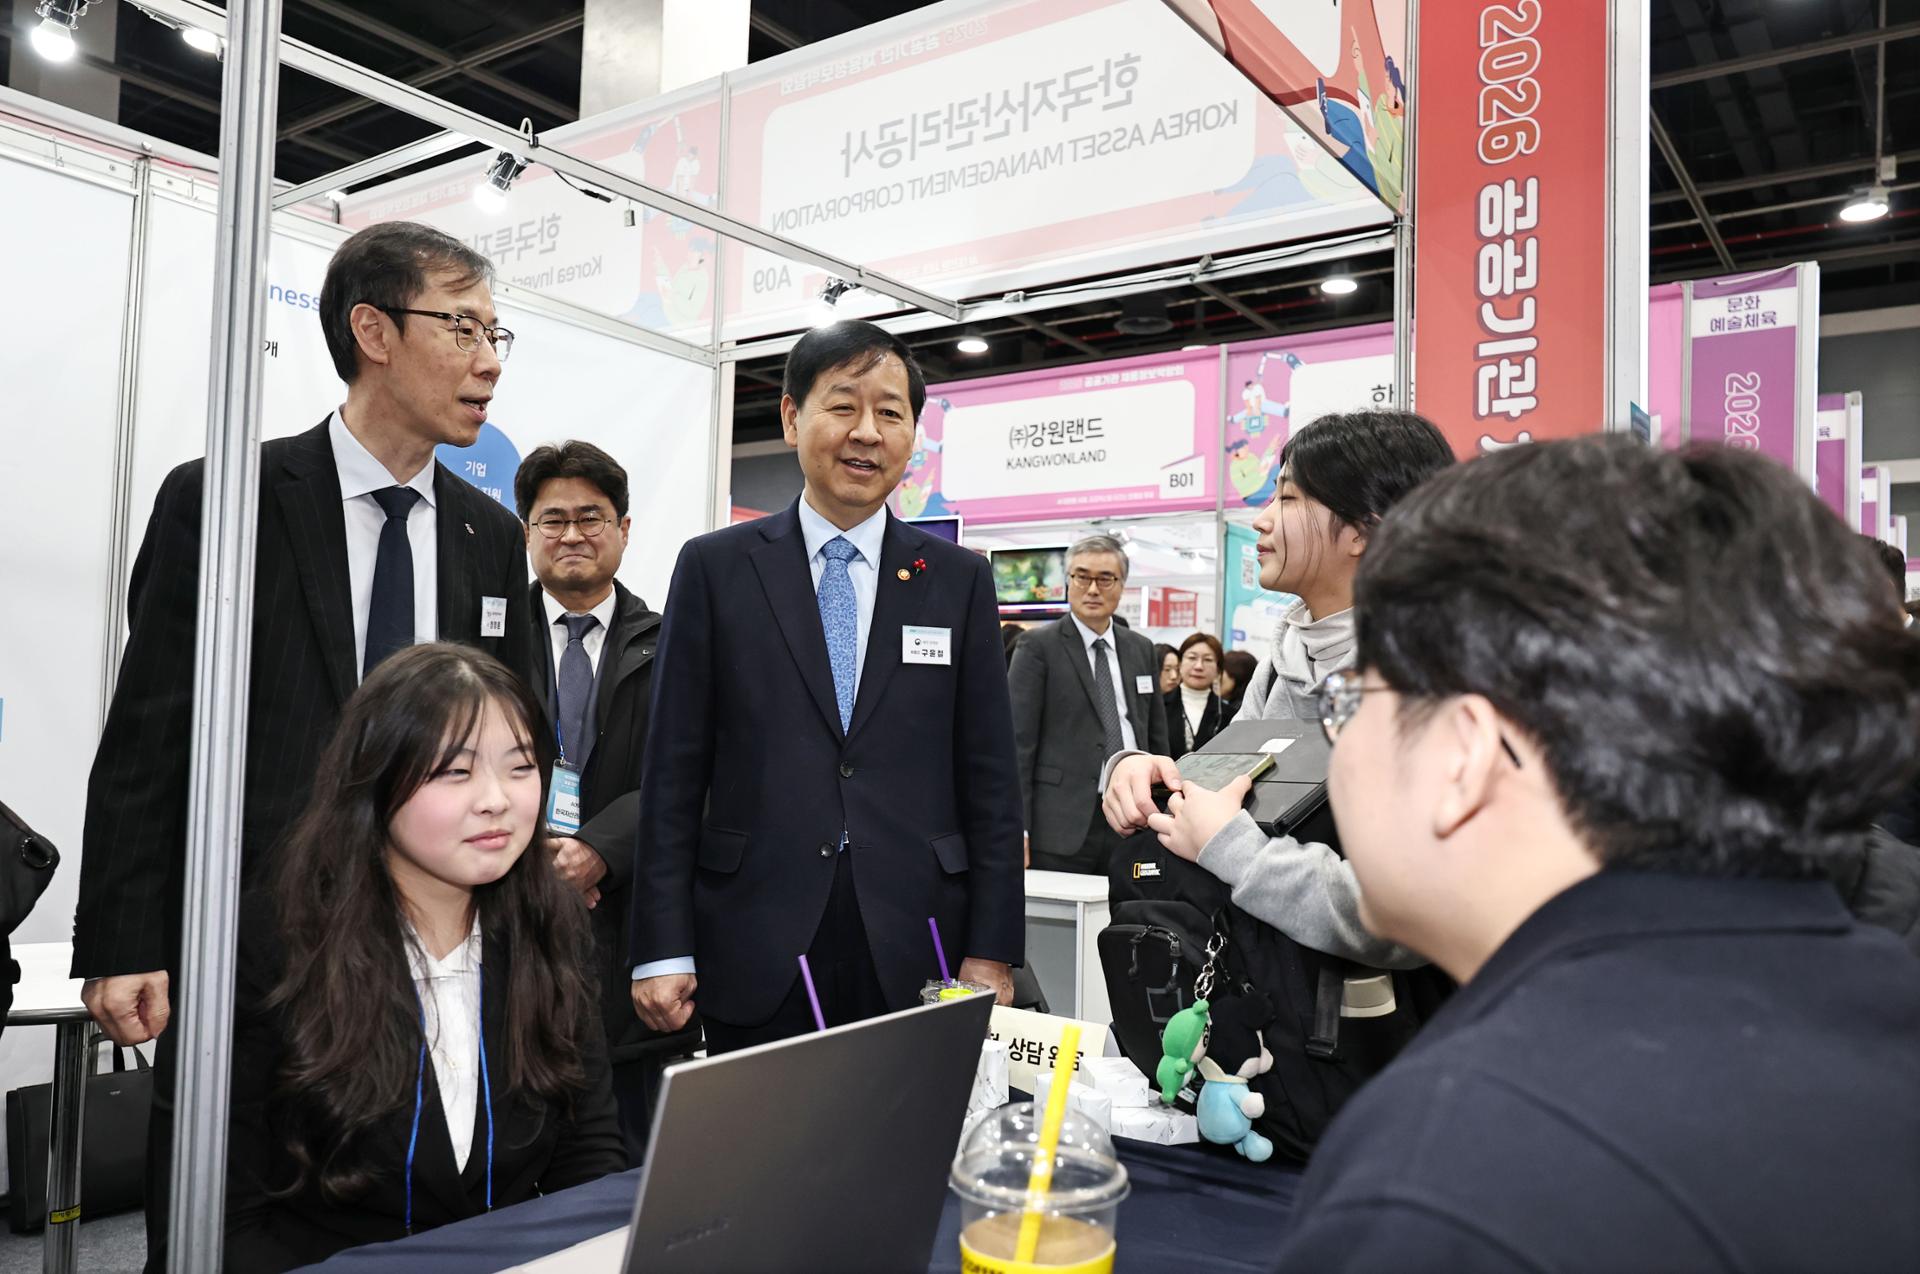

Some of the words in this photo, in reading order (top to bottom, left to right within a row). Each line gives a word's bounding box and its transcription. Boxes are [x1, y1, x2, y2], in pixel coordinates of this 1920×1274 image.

[1477, 0, 1542, 165] 2026
[1476, 176, 1538, 418] 공공기관
[1727, 295, 1761, 314] 문화
[1710, 311, 1778, 333] 예술체육
[465, 461, 487, 477] 기업
[1006, 449, 1107, 470] KANGWONLAND
[1169, 473, 1194, 488] B01
[1008, 1037, 1045, 1066] 상담
